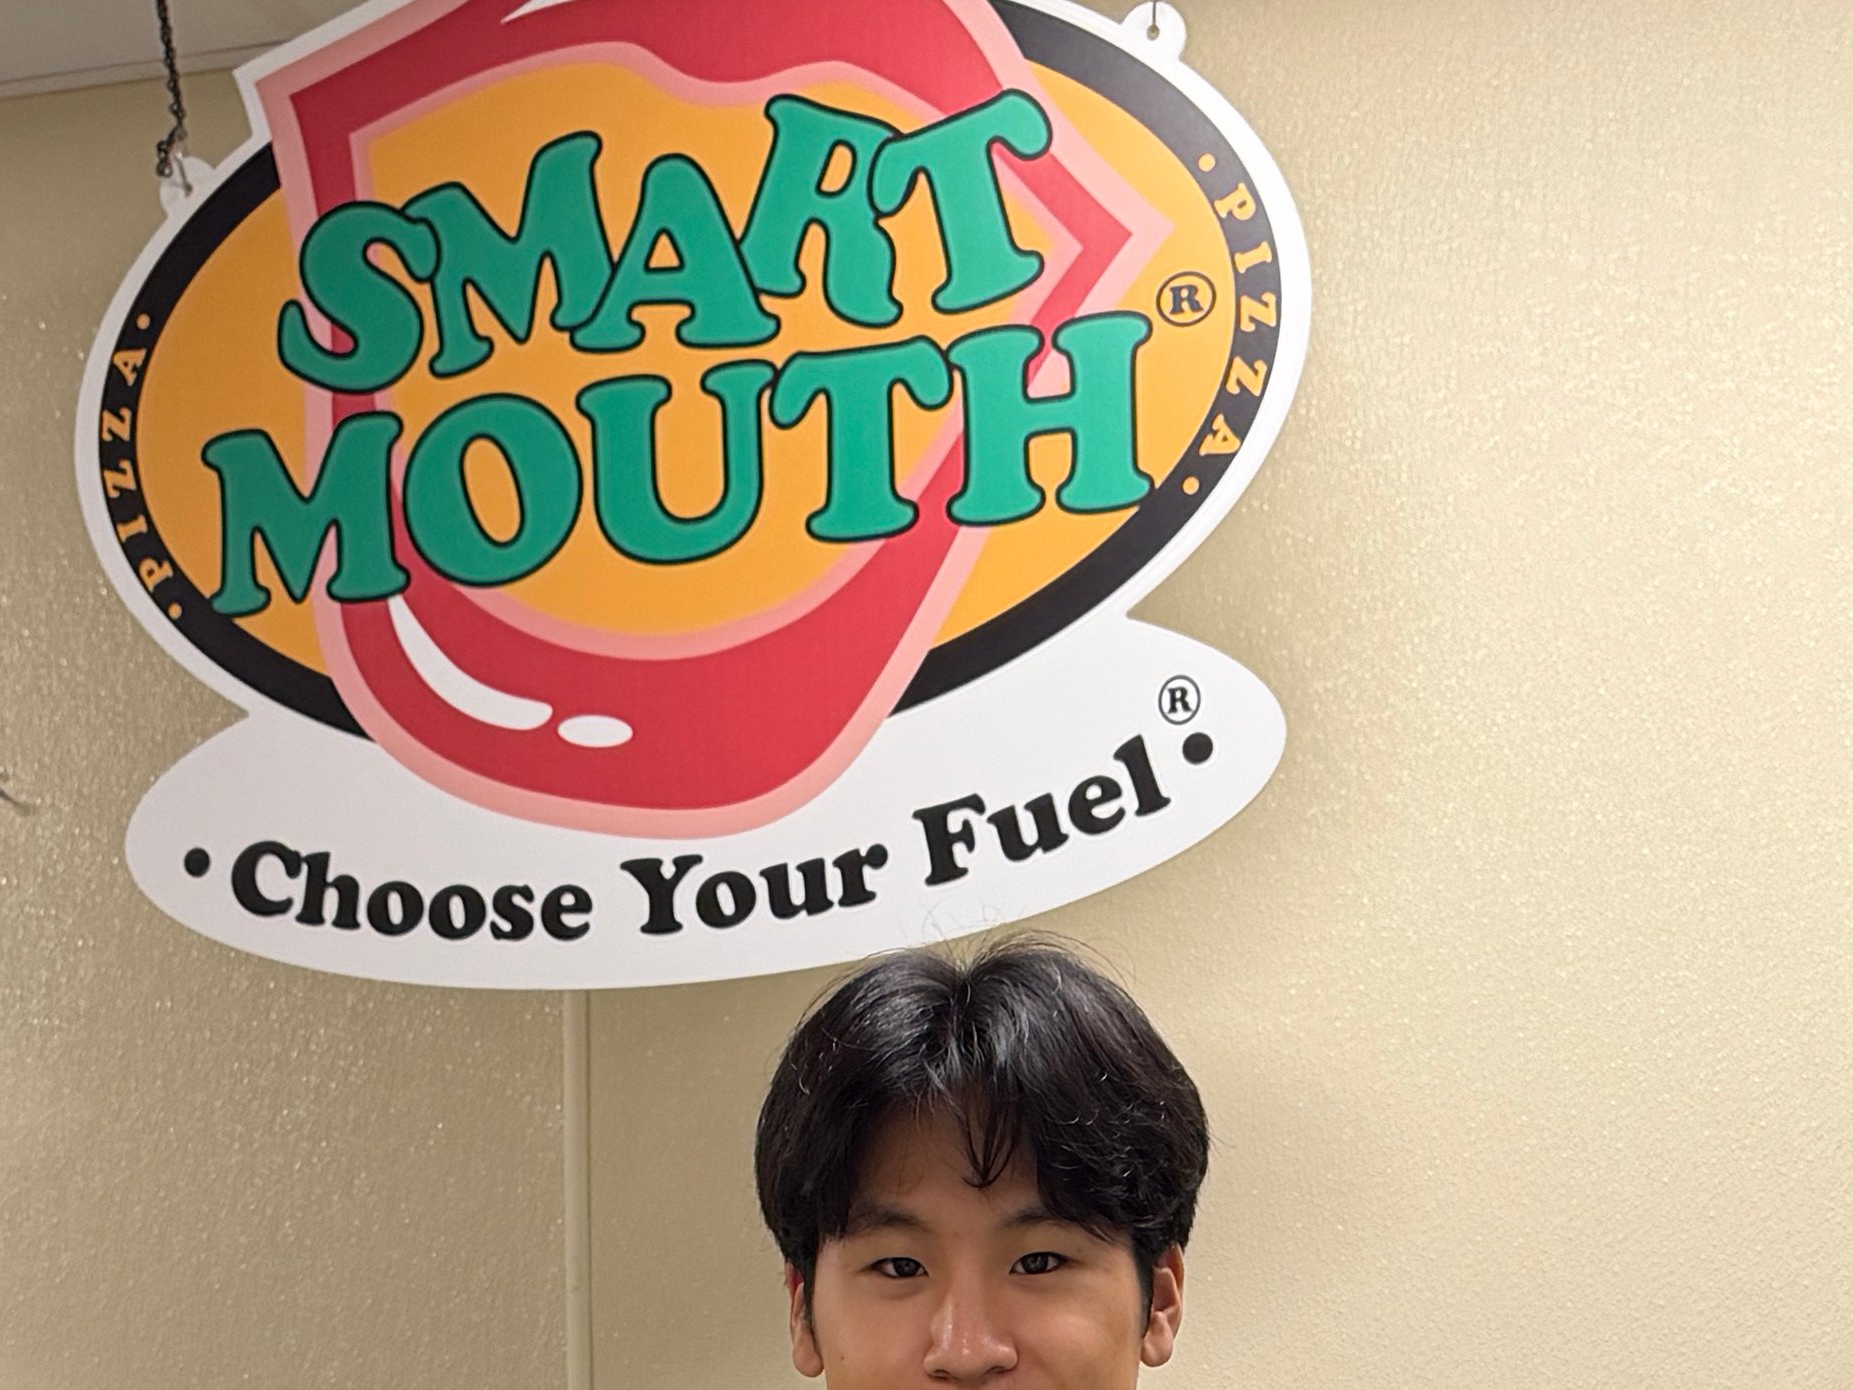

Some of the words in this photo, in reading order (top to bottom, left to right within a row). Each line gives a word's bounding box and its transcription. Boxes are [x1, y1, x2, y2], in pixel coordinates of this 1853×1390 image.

[277, 89, 1052, 394] SMART
[1198, 182, 1277, 456] PIZZA
[100, 348, 174, 593] PIZZA
[203, 309, 1152, 618] MOUTH
[230, 839, 595, 942] Choose
[620, 843, 889, 937] Your
[911, 733, 1172, 888] Fuel
